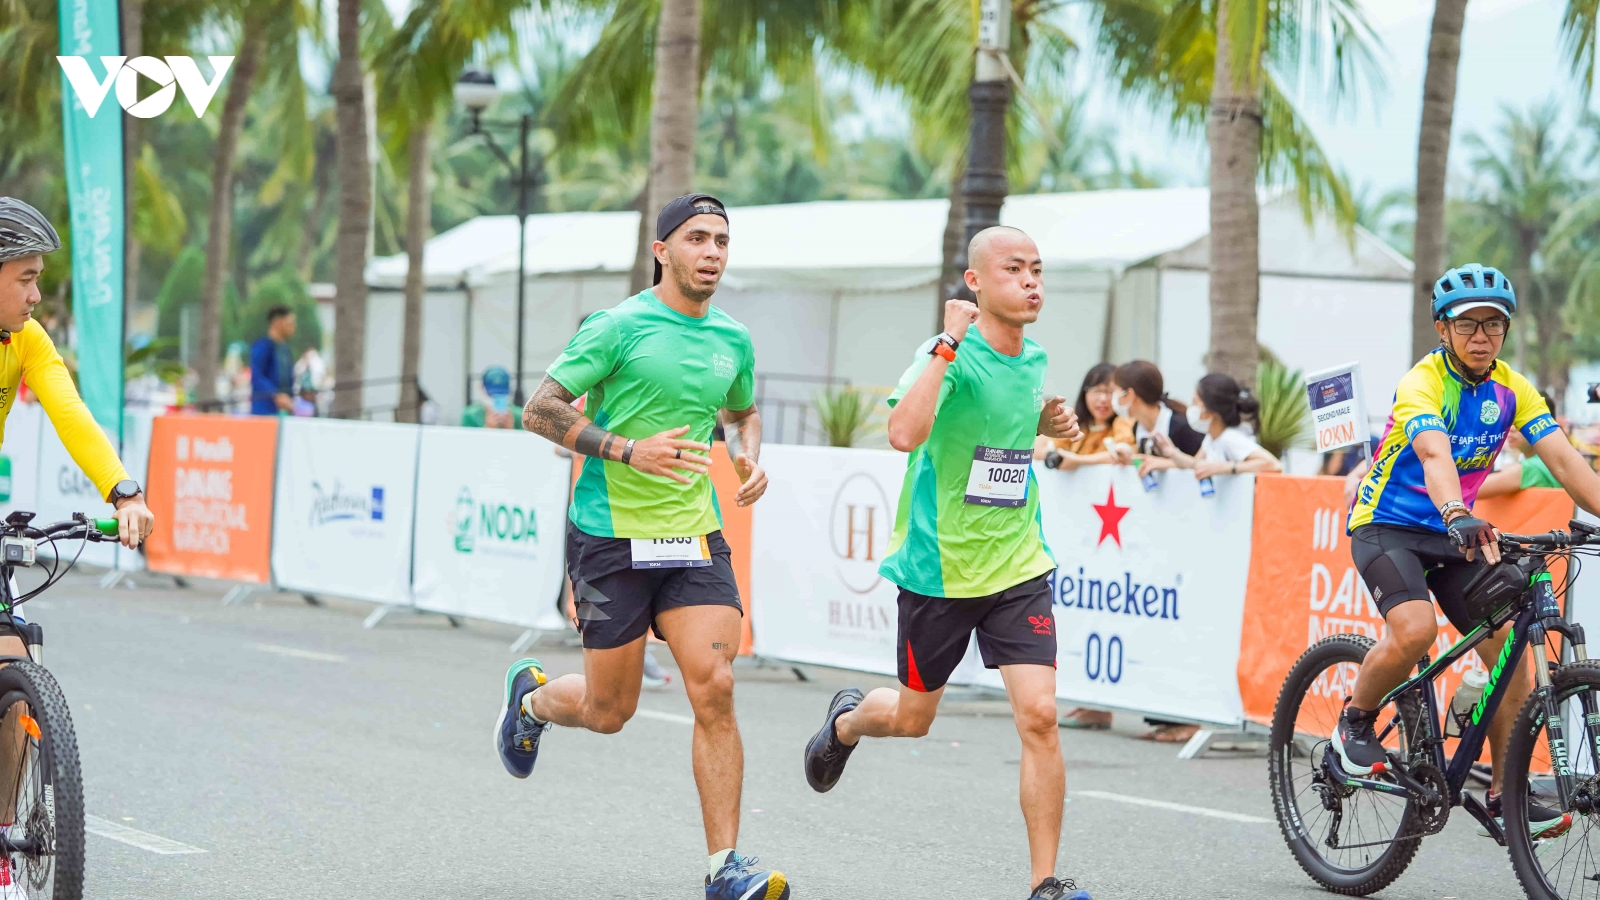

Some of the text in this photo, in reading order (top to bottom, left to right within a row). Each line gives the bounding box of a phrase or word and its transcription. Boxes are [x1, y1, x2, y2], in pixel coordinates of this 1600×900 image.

[1317, 406, 1350, 423] SECOND MALE
[1319, 421, 1355, 449] 10KM
[988, 467, 1026, 484] 10020
[480, 503, 539, 544] NODA
[1086, 633, 1123, 684] 0.0
